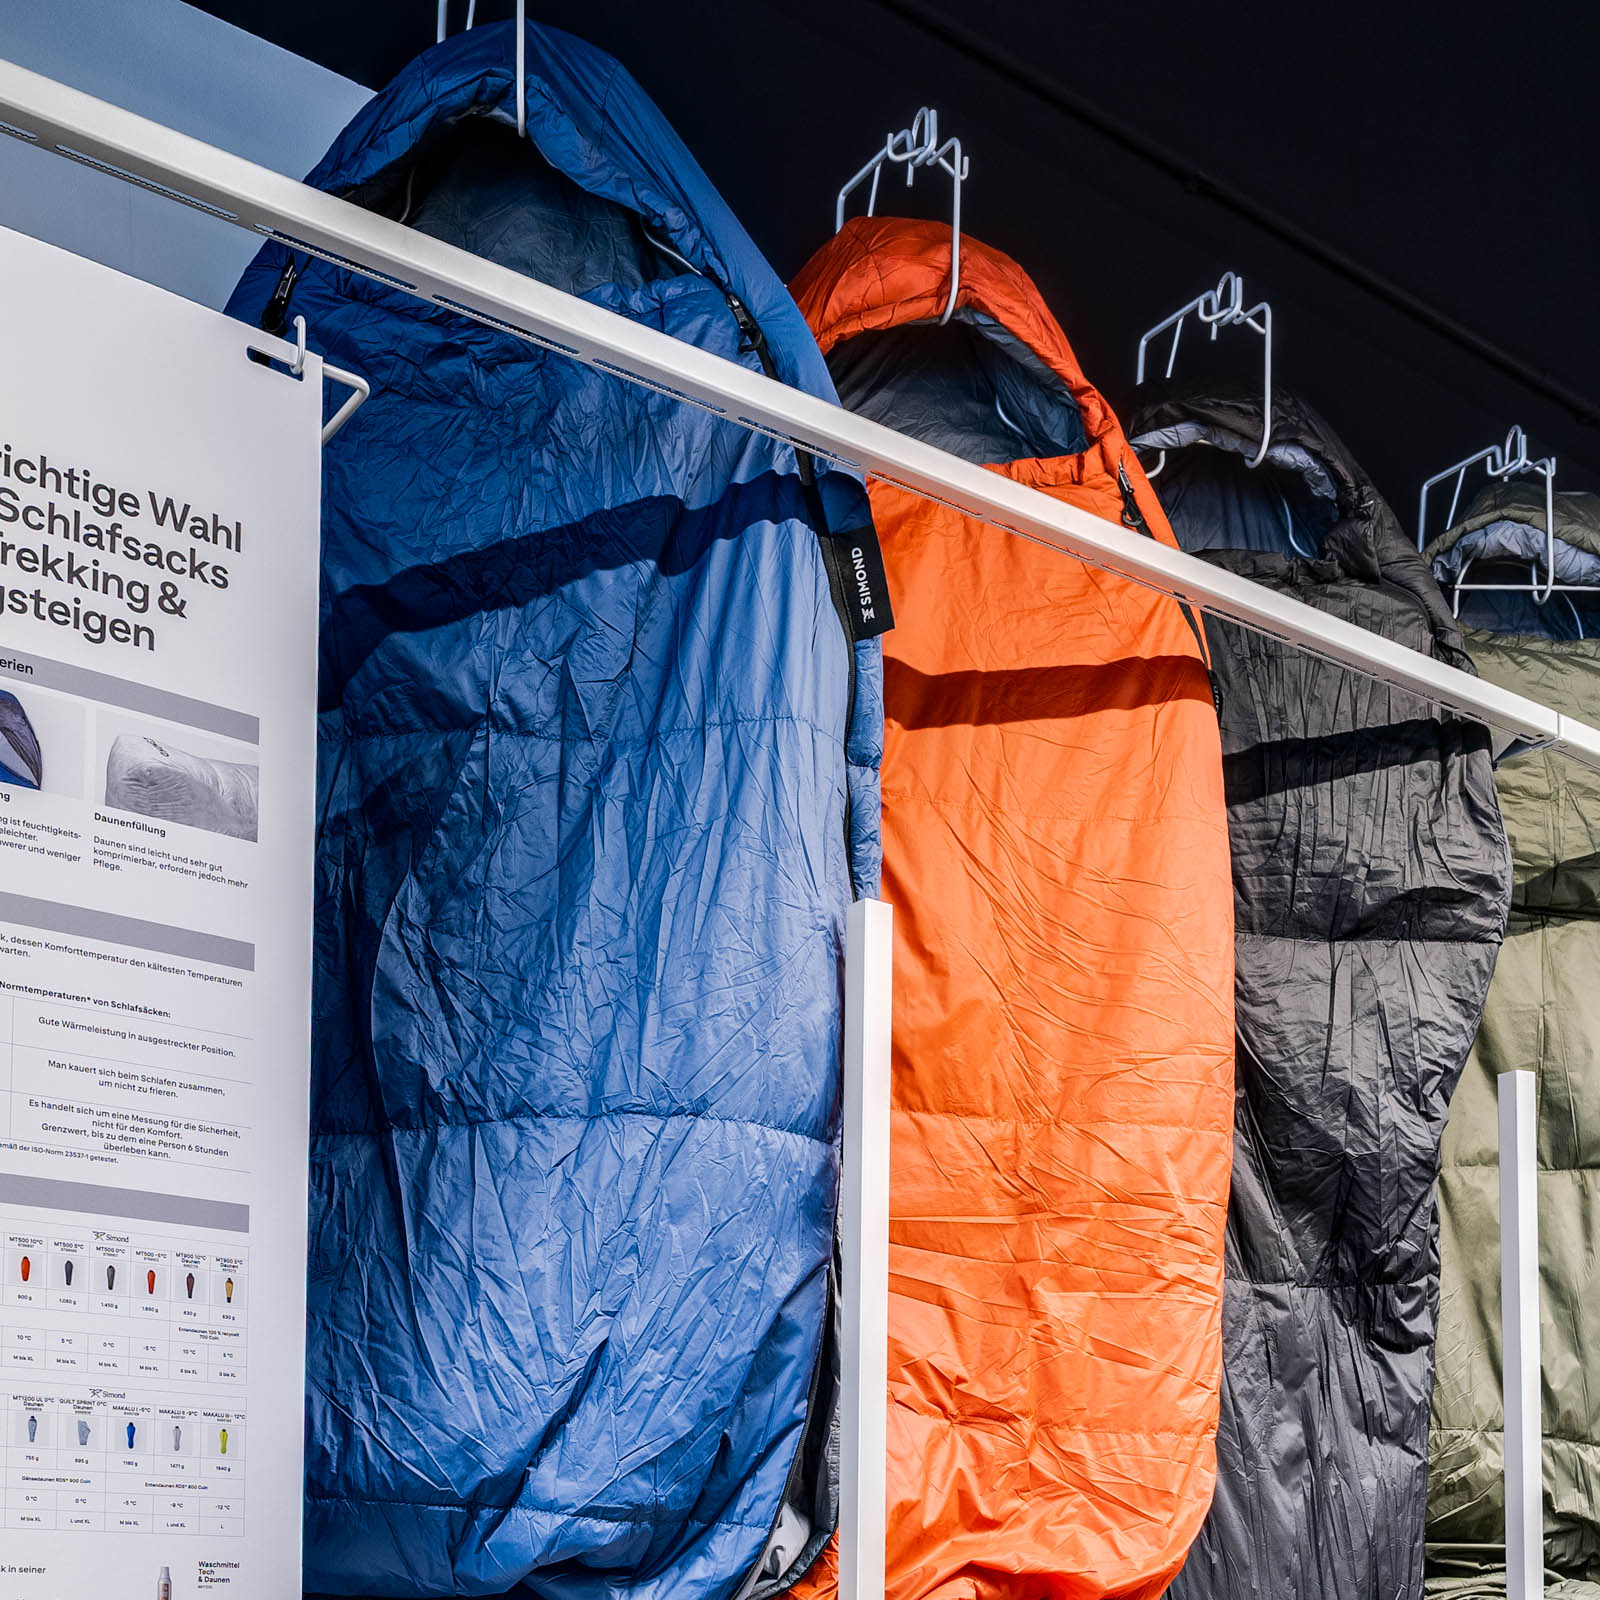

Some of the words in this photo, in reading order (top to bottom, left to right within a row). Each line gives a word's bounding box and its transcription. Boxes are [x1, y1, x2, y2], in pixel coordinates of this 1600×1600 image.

[148, 490, 242, 553] Wahl
[852, 547, 871, 605] SIMOND
[158, 580, 187, 619] &
[94, 813, 166, 838] Daunenfüllung
[38, 1016, 59, 1028] Gute
[62, 1019, 126, 1039] Wärmeleistung
[128, 1031, 136, 1039] in
[138, 1033, 199, 1051] ausgestreckter
[202, 1043, 236, 1058] Position.
[105, 1234, 129, 1243] Simond
[8, 1564, 16, 1574] in
[19, 1566, 46, 1574] seiner
